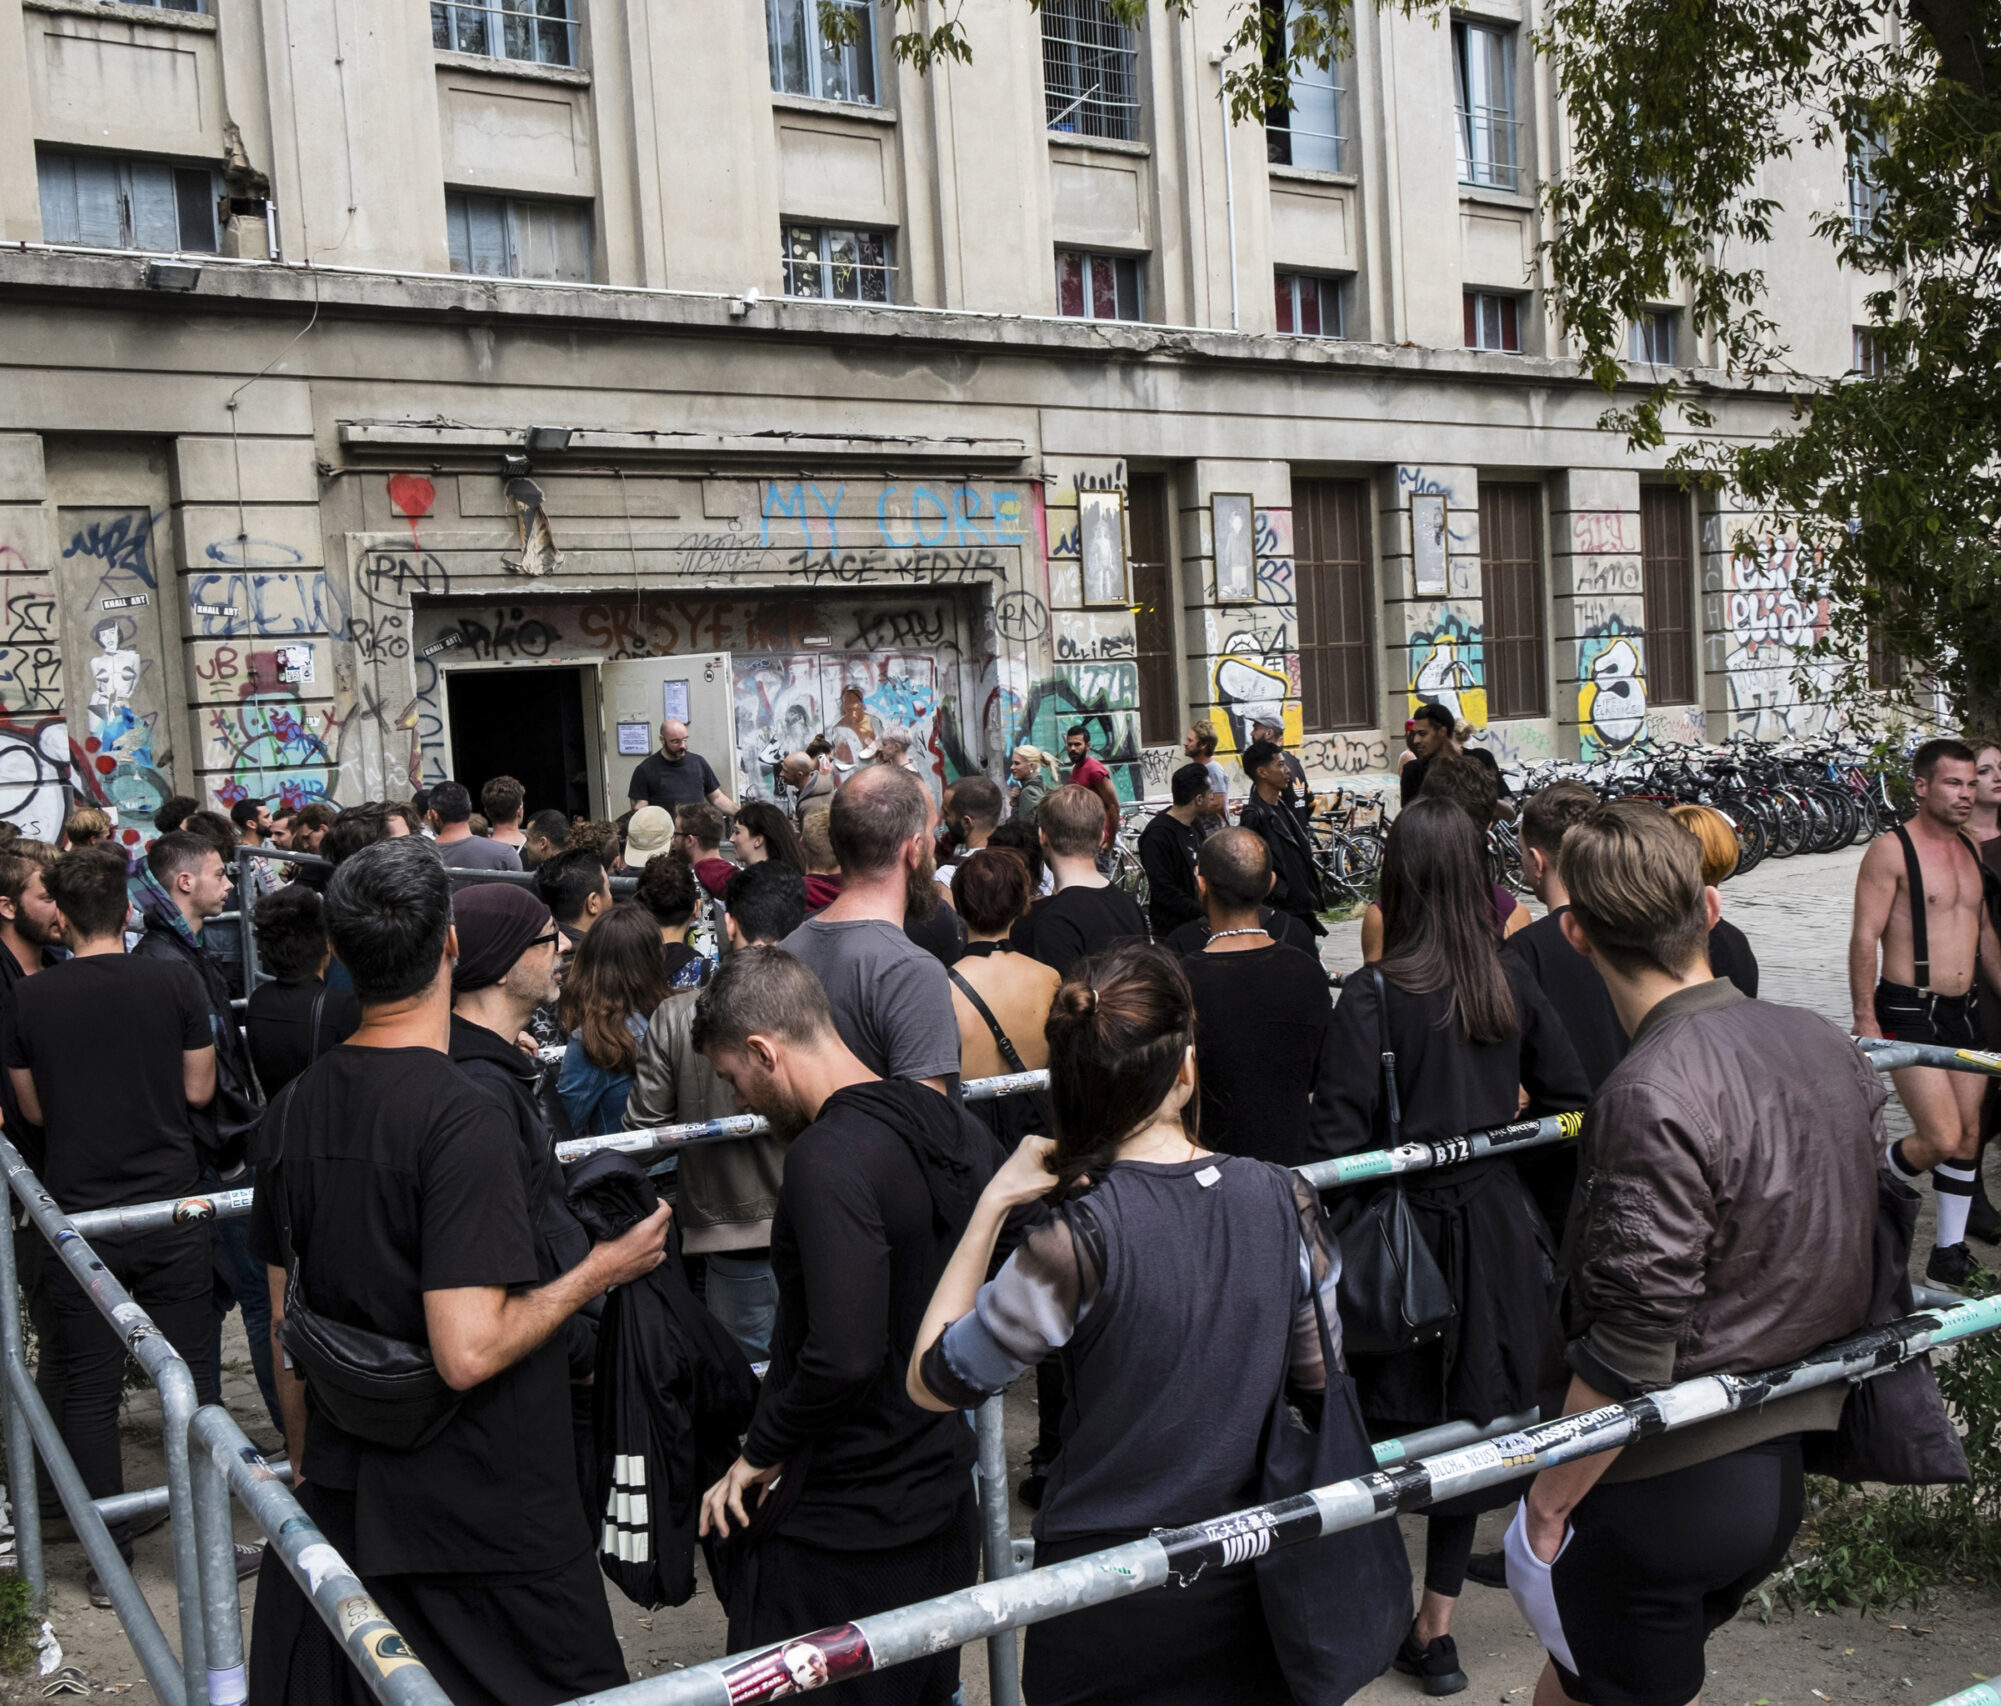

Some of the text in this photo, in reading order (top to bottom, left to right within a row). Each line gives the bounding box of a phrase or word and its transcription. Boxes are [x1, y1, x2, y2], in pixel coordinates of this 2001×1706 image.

[760, 482, 844, 557] MY
[877, 485, 1023, 548] CORE
[1435, 1140, 1470, 1163] BTZ
